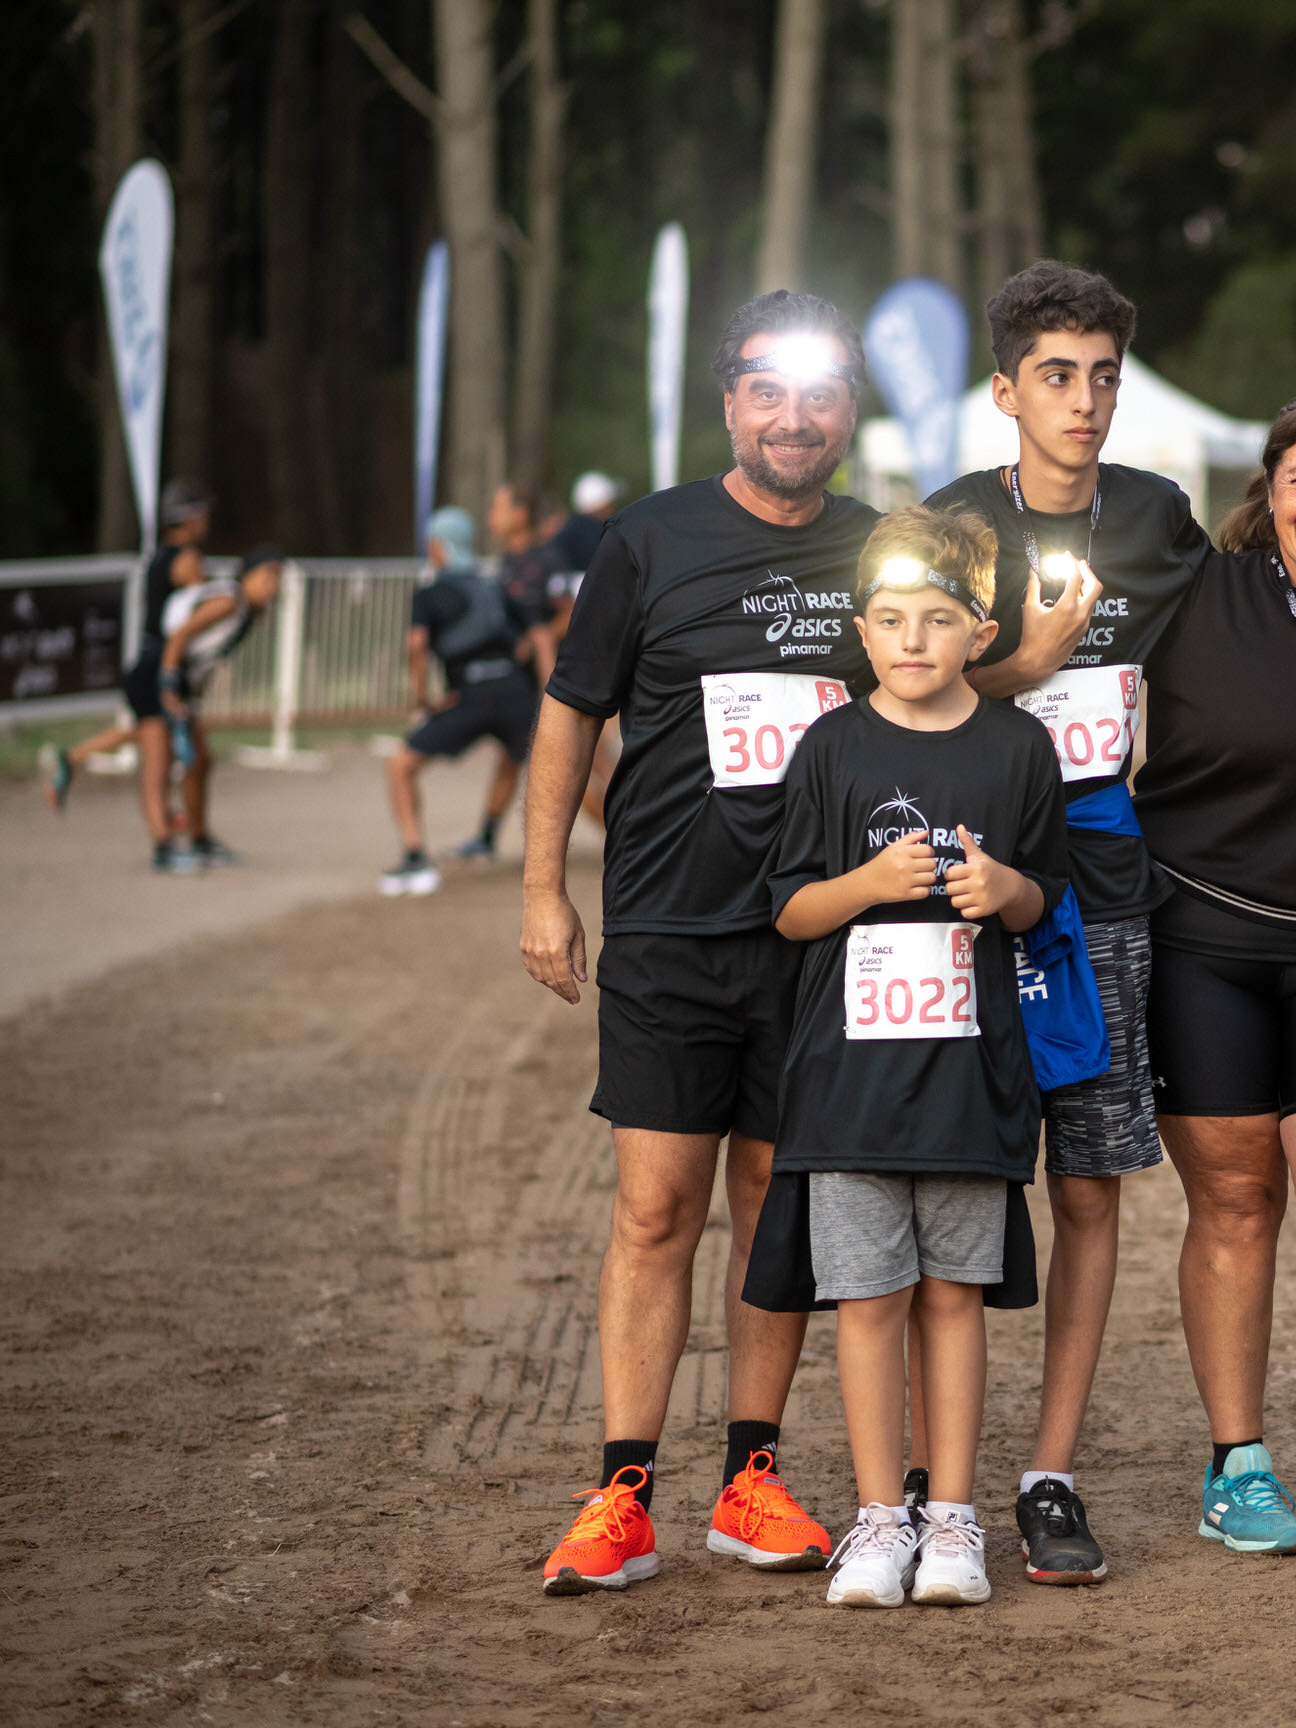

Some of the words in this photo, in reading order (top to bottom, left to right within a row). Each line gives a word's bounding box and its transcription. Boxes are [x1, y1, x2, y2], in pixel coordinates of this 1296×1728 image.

[741, 593, 798, 614] NIGHT
[804, 592, 853, 610] RACE
[1092, 598, 1129, 617] ACE
[791, 619, 842, 637] asics
[1078, 627, 1115, 646] ICS
[780, 643, 832, 657] pinamar
[1066, 654, 1102, 665] amar
[1126, 677, 1134, 691] 5
[710, 695, 735, 705] NIGHT
[739, 694, 762, 702] RACE
[825, 687, 837, 700] 5
[1020, 696, 1043, 707] NIGHT
[1047, 692, 1069, 702] RACE
[1041, 705, 1059, 713] asics
[872, 946, 894, 954] RACE
[960, 935, 969, 951] 5
[955, 951, 973, 965] KM
[856, 976, 971, 1025] 3022
